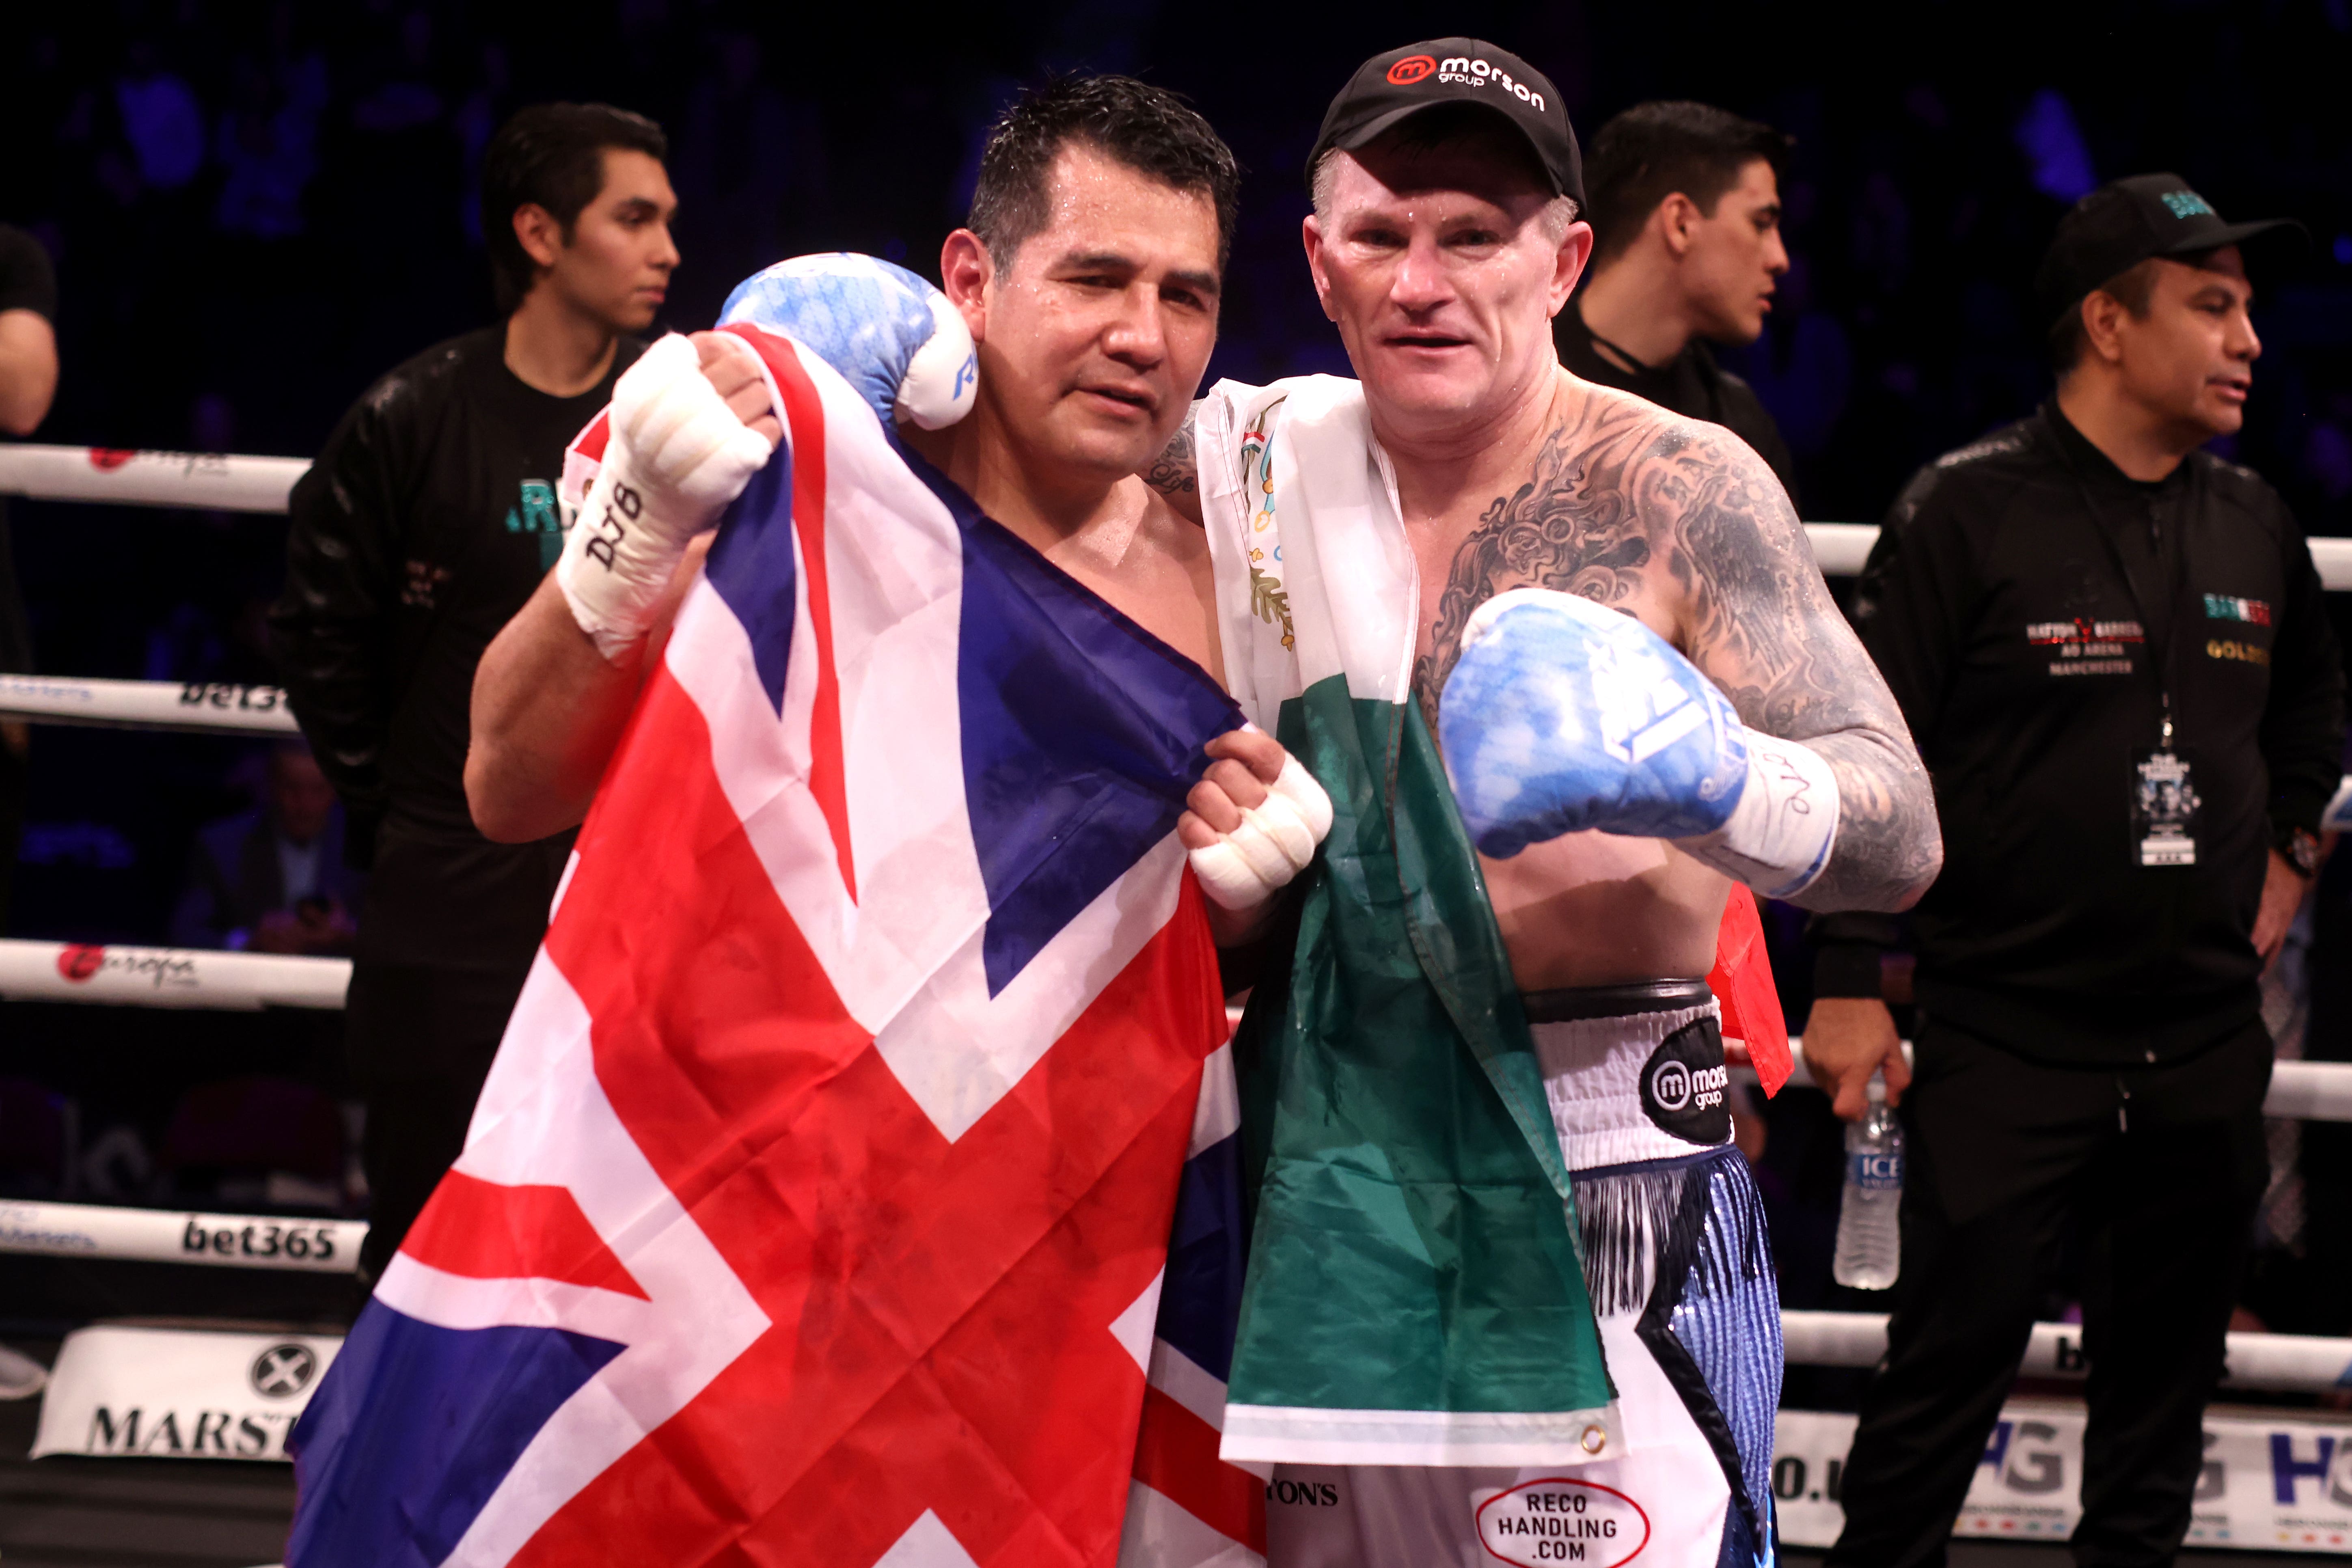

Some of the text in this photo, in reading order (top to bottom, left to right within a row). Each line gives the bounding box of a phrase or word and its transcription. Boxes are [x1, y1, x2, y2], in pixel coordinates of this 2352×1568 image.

[1438, 71, 1485, 87] group
[1440, 57, 1546, 112] morson
[1694, 1090, 1723, 1111] group
[183, 1220, 335, 1259] bet365
[1526, 1493, 1587, 1514] RECO
[1498, 1516, 1617, 1538] HANDLING
[1532, 1541, 1585, 1562] .COM
